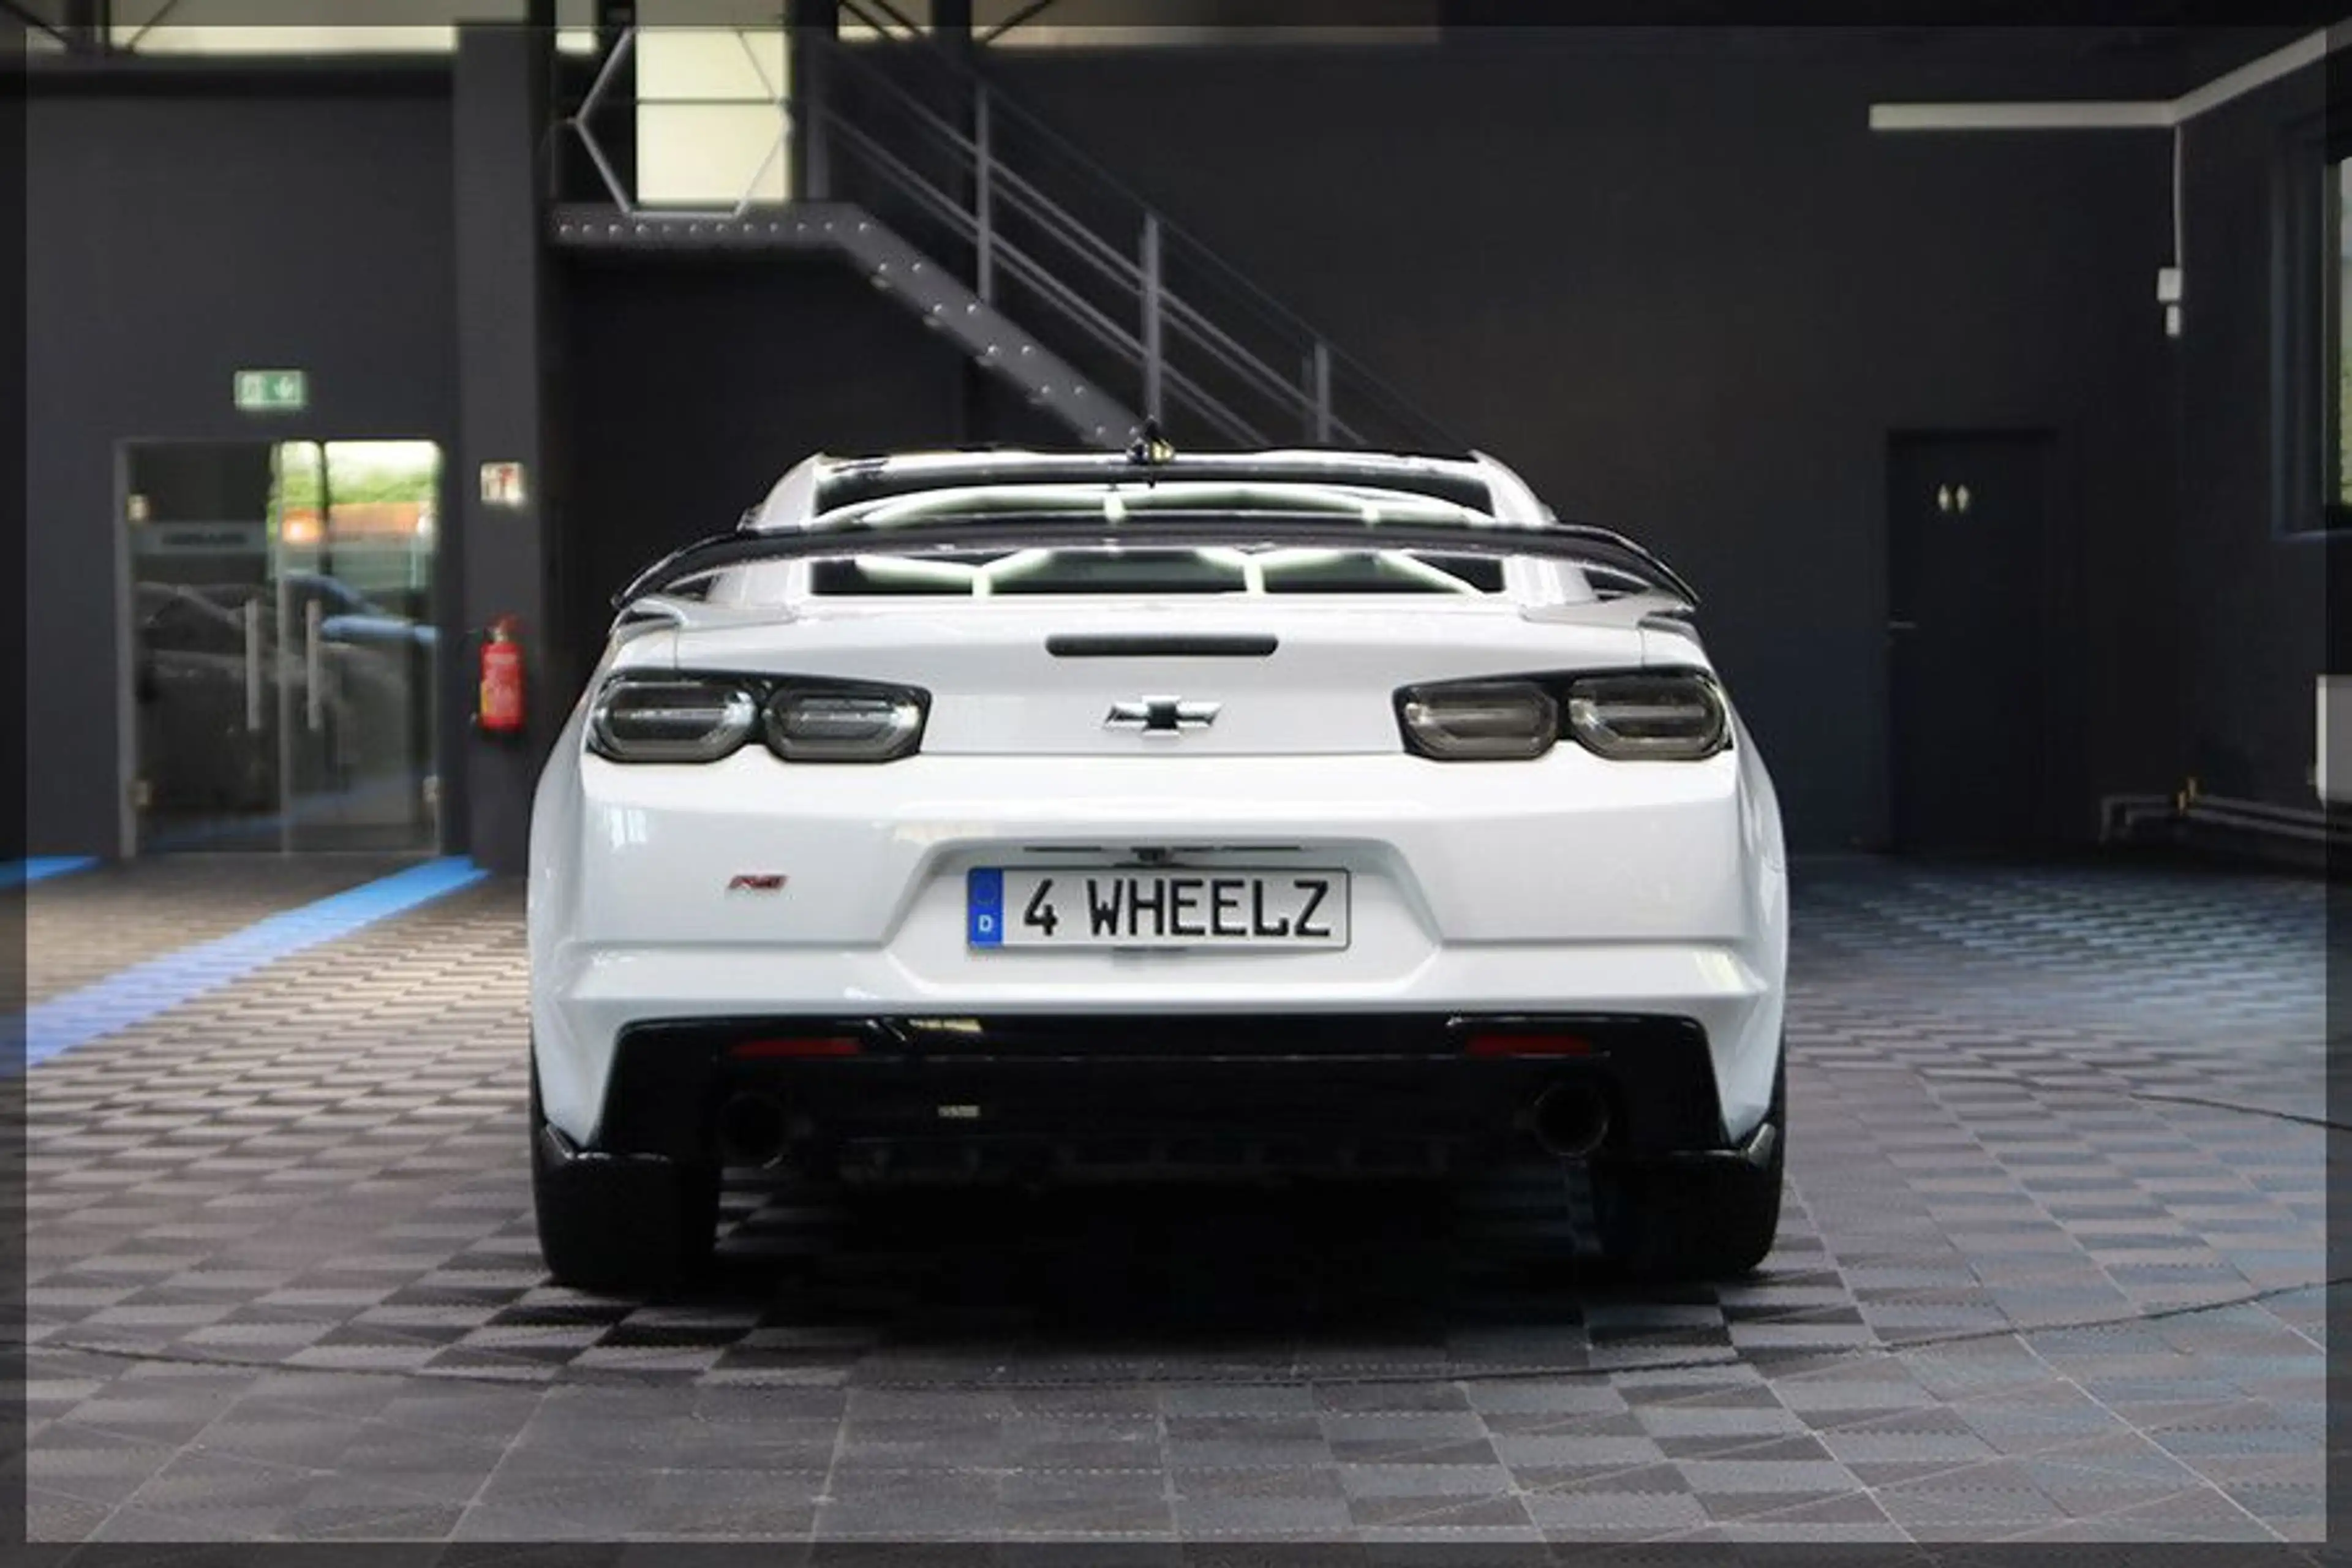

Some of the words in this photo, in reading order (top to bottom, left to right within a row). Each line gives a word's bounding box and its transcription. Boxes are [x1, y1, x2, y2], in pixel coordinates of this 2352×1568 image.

[979, 914, 993, 932] D
[1023, 878, 1059, 937] 4
[1087, 878, 1331, 938] WHEELZ
